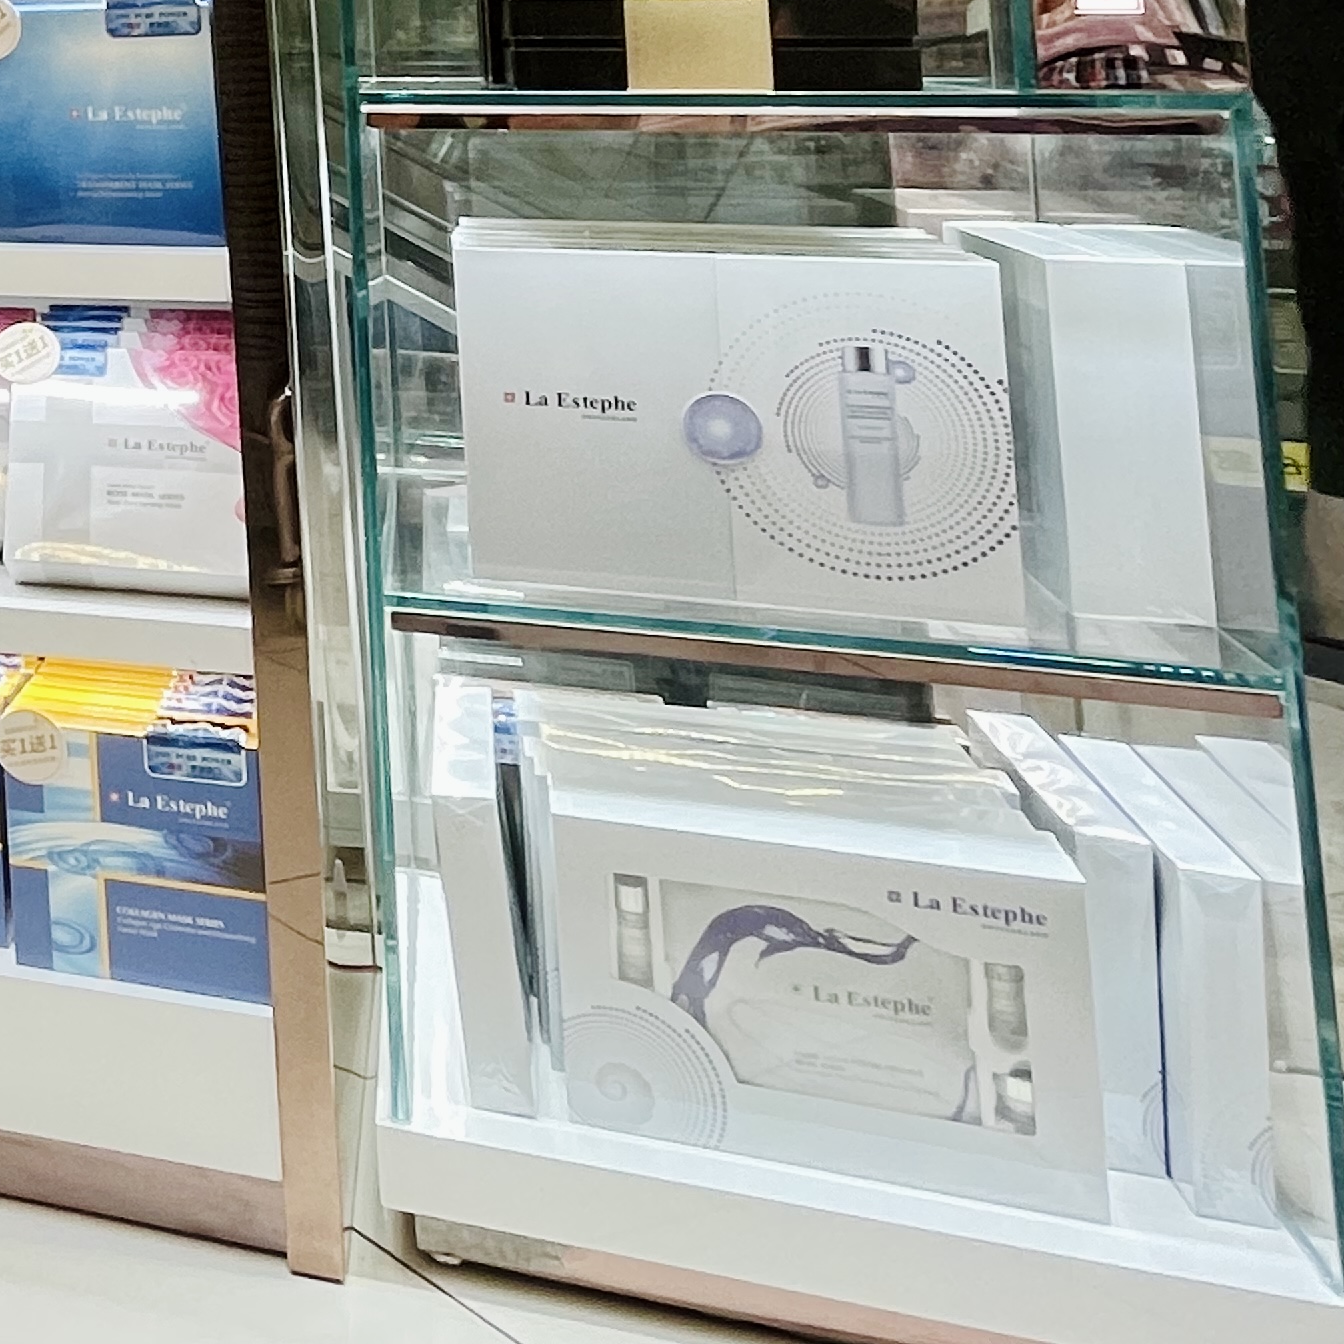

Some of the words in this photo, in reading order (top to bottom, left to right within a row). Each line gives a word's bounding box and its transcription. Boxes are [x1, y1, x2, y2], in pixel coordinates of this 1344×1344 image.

[86, 106, 108, 122] La
[112, 104, 184, 124] Estephe
[525, 391, 548, 406] La
[557, 392, 637, 413] Estephe
[123, 437, 142, 452] La
[148, 438, 207, 456] Estephe
[126, 790, 149, 810] La
[156, 794, 230, 821] Estephe
[913, 891, 941, 911] La
[950, 896, 1048, 926] Estephe
[813, 985, 840, 1005] La
[847, 991, 932, 1016] Estephe
